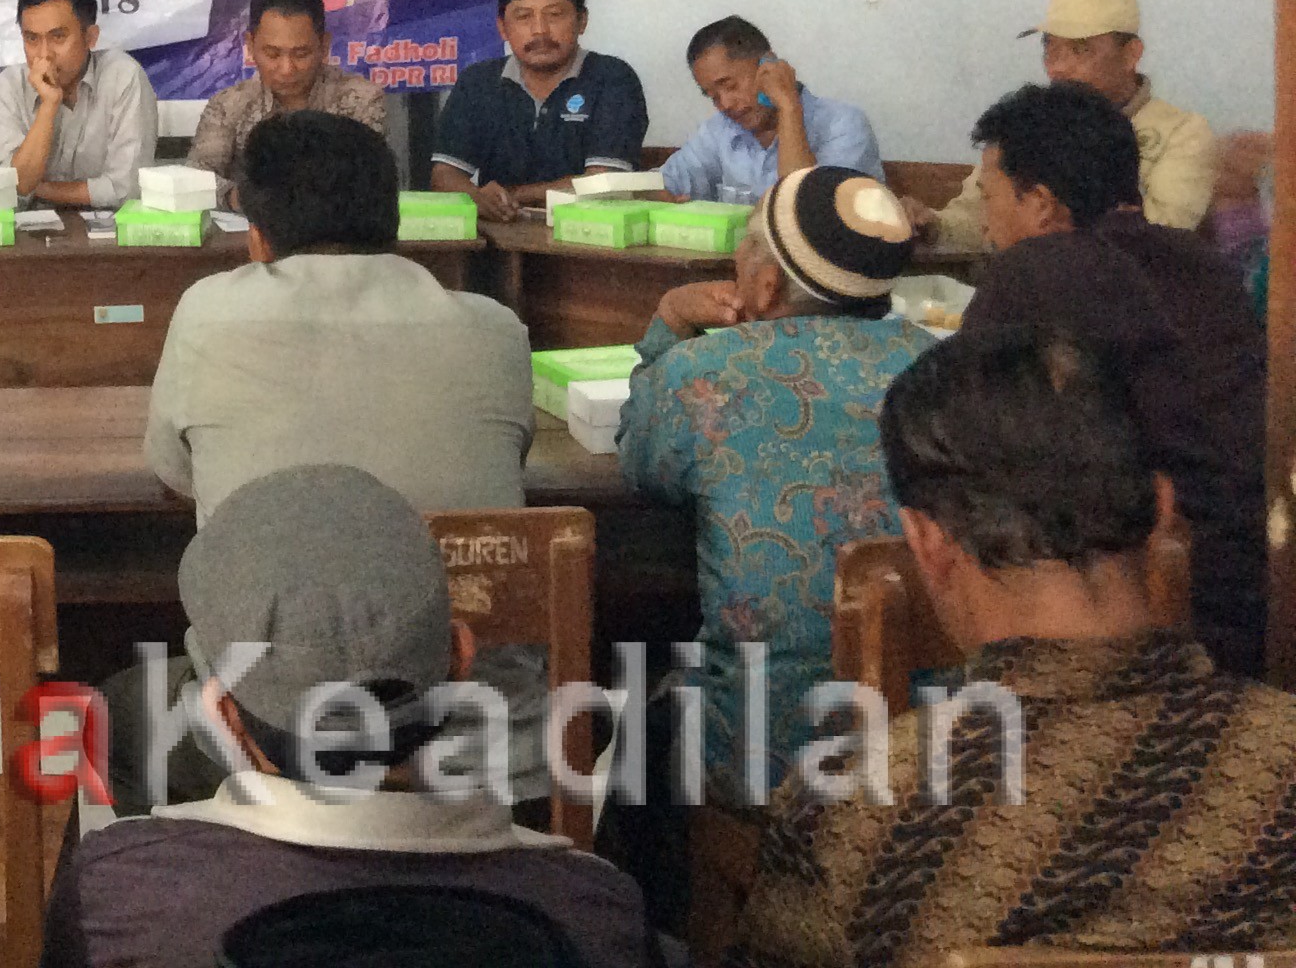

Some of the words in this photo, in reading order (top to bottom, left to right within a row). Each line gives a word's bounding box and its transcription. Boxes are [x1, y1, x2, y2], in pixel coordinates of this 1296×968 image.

[347, 36, 458, 65] Fadholi
[370, 66, 425, 87] DPR
[430, 64, 457, 85] RI
